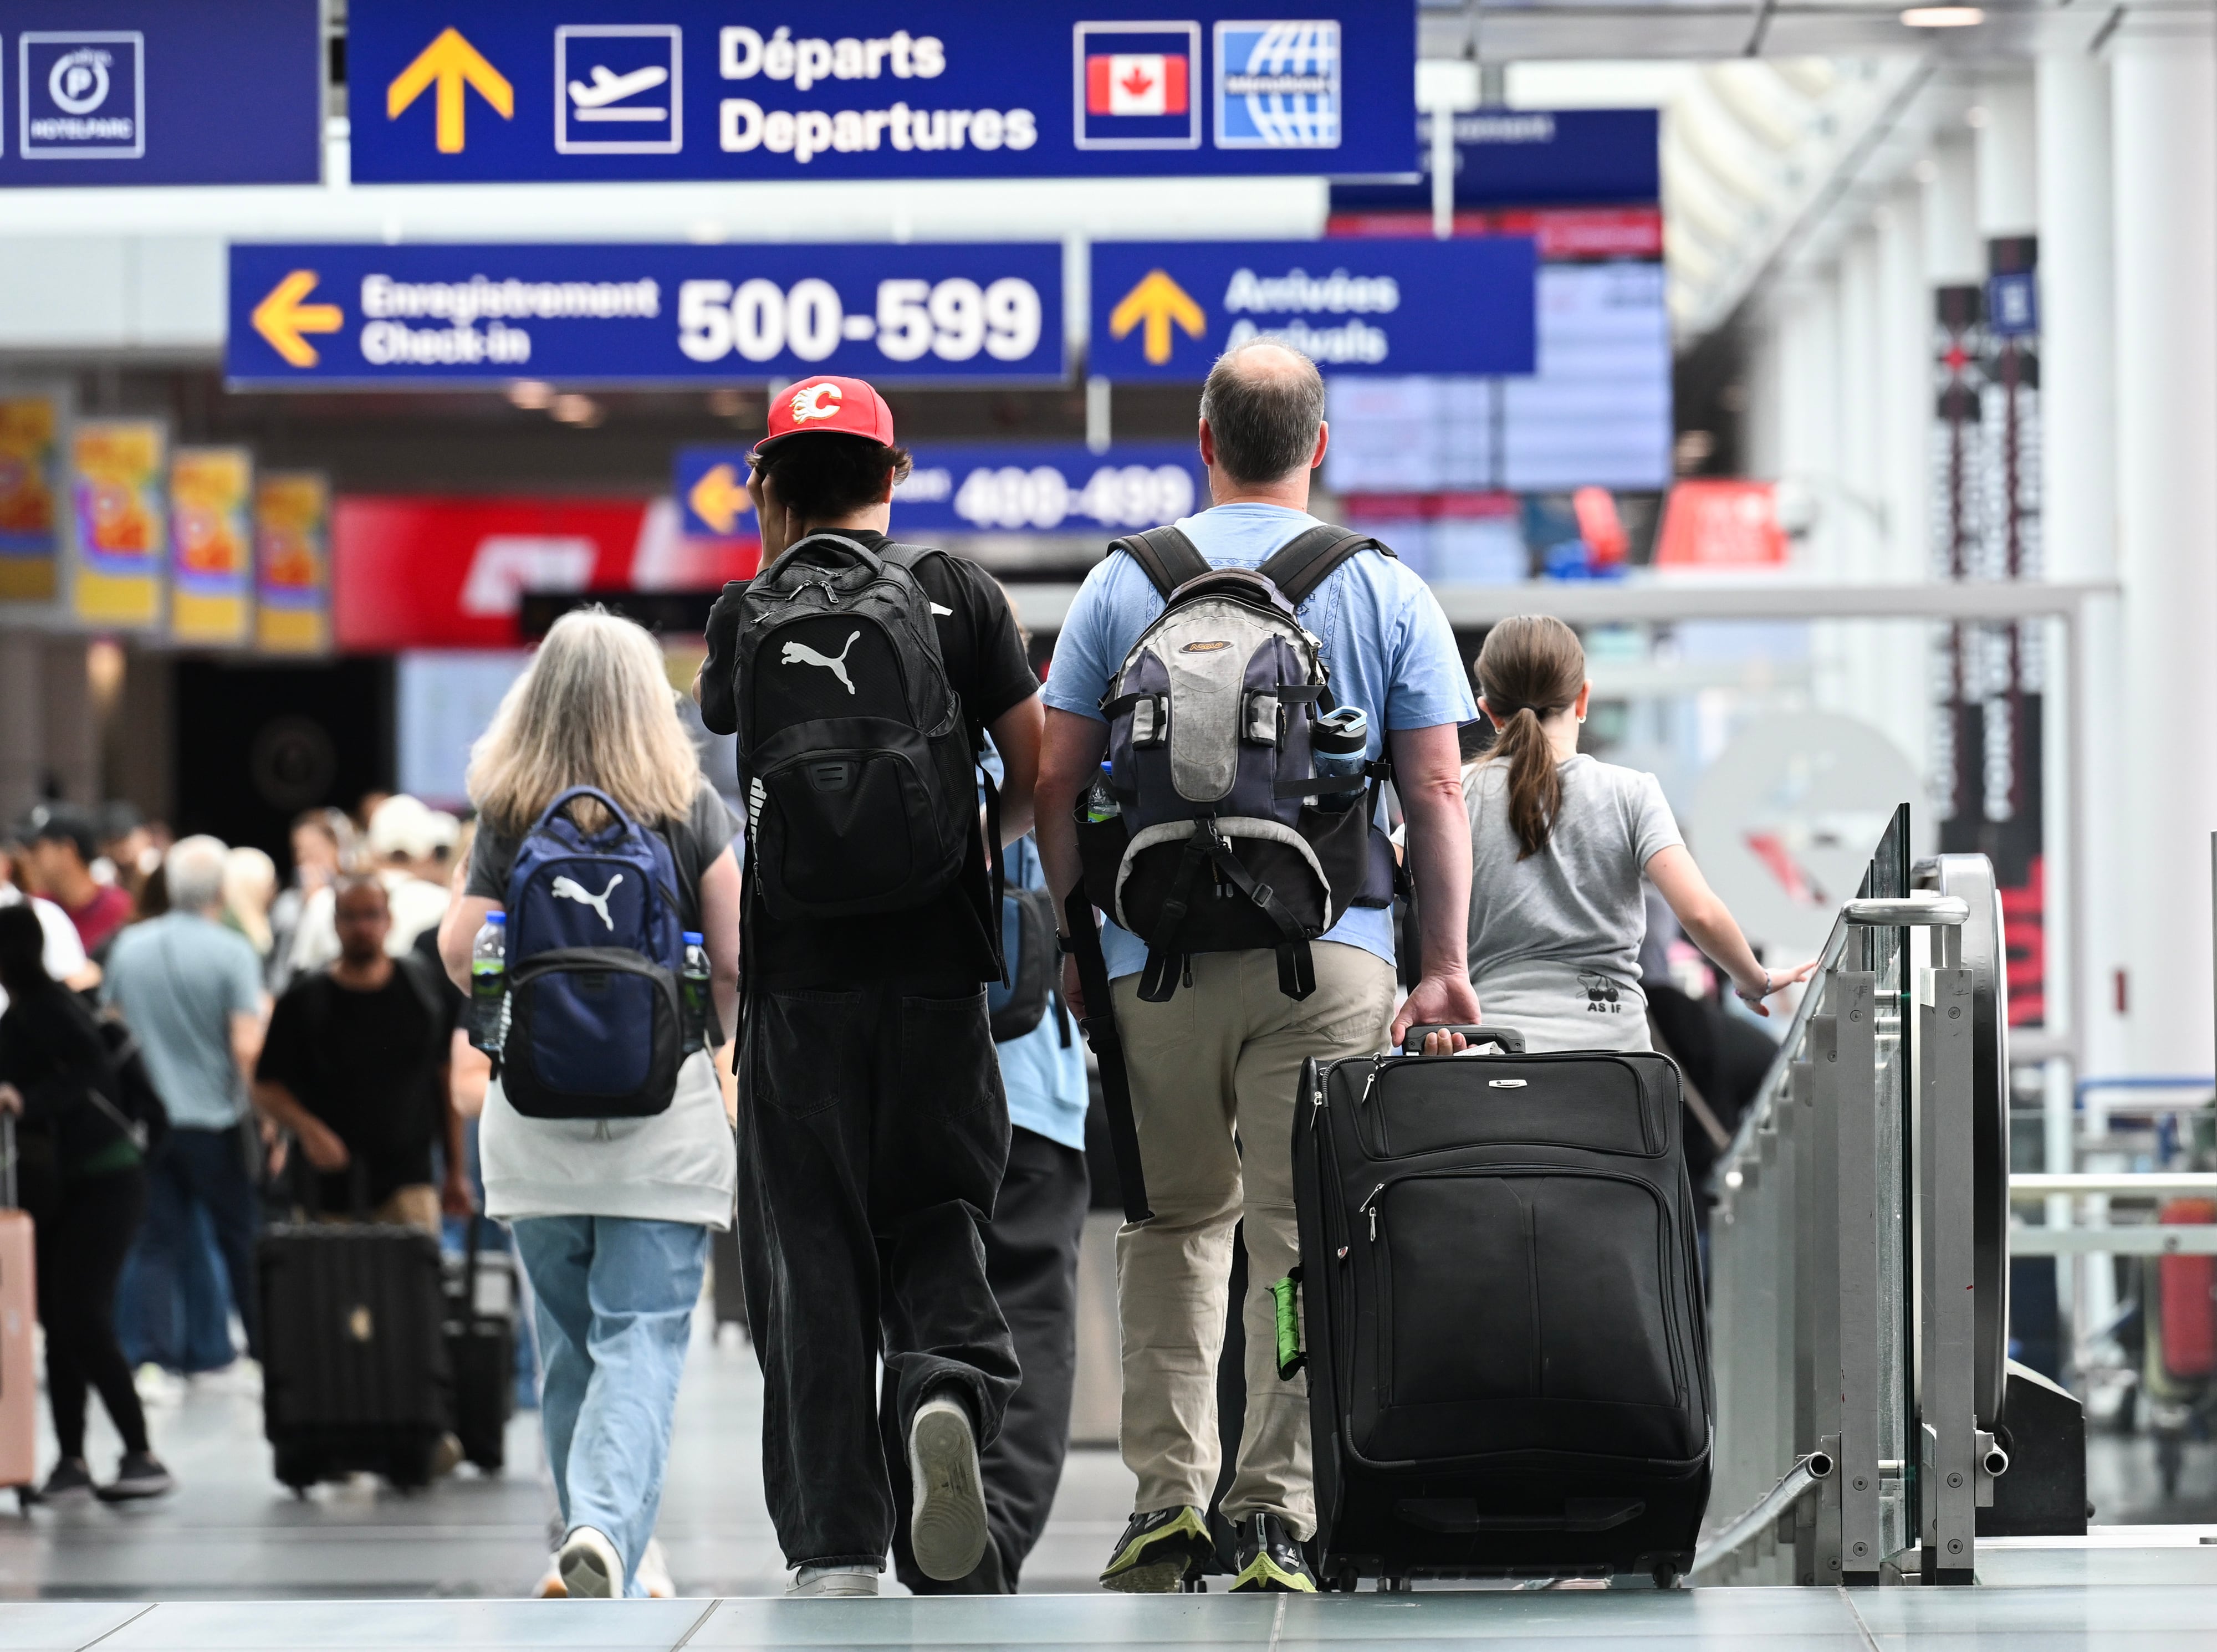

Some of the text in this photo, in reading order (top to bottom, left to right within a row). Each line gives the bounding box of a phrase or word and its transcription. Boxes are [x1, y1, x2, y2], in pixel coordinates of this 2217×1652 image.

[719, 26, 946, 91] Départs
[720, 99, 1037, 163] Departures
[361, 274, 660, 327] Enregistrement
[1223, 268, 1400, 314] Arrivées
[360, 321, 531, 365] Check-in
[678, 278, 1041, 362] 500-599
[1224, 318, 1389, 364] Aivals
[954, 464, 1195, 529] 400-499
[1189, 642, 1224, 651] ASOLO
[1587, 1002, 1622, 1014] AS IF
